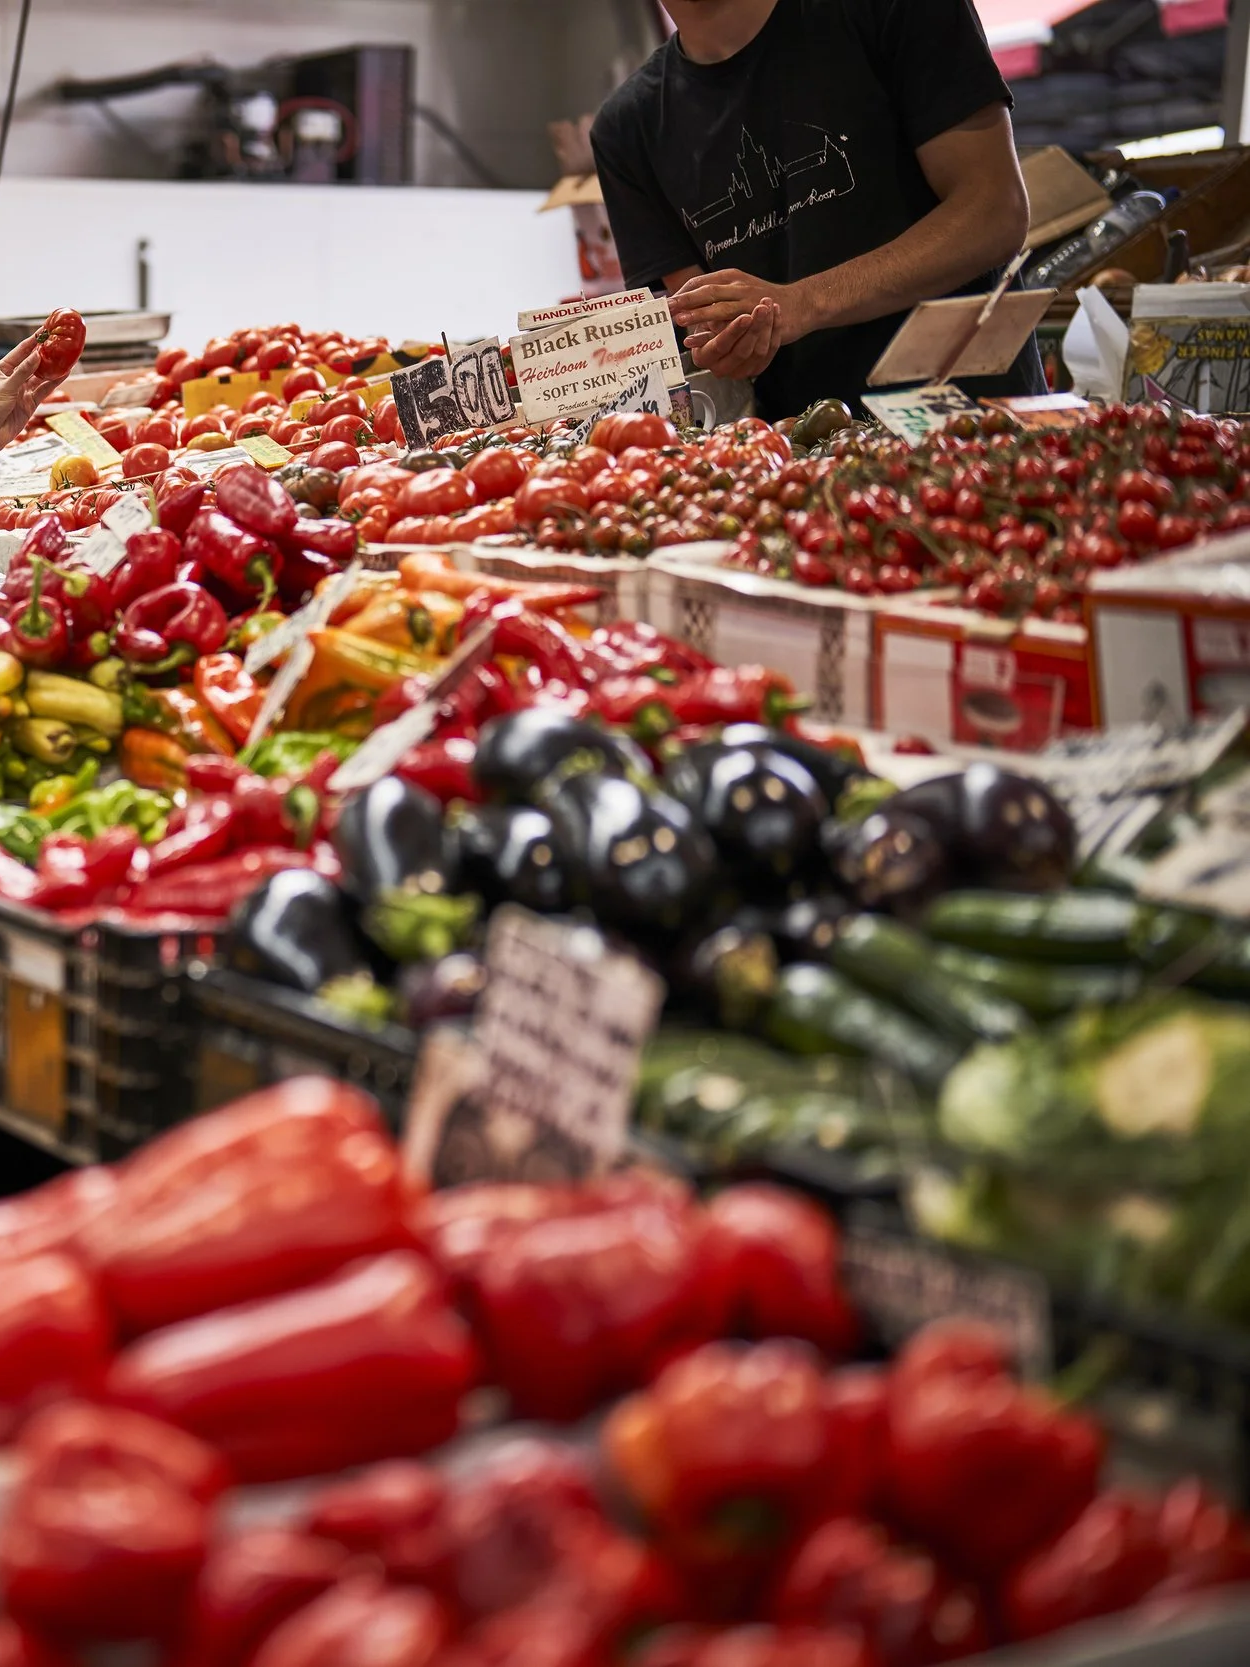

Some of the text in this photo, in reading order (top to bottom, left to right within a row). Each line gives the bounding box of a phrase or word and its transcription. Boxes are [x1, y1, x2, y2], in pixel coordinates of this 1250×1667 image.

[808, 188, 836, 206] Room
[532, 292, 645, 322] HANDLE WITH CARE
[520, 309, 669, 360] Black Russian
[519, 338, 664, 385] Heirloom Tomatoes
[583, 372, 617, 391] SKIN
[557, 400, 589, 414] Produce
[590, 396, 599, 406] of
